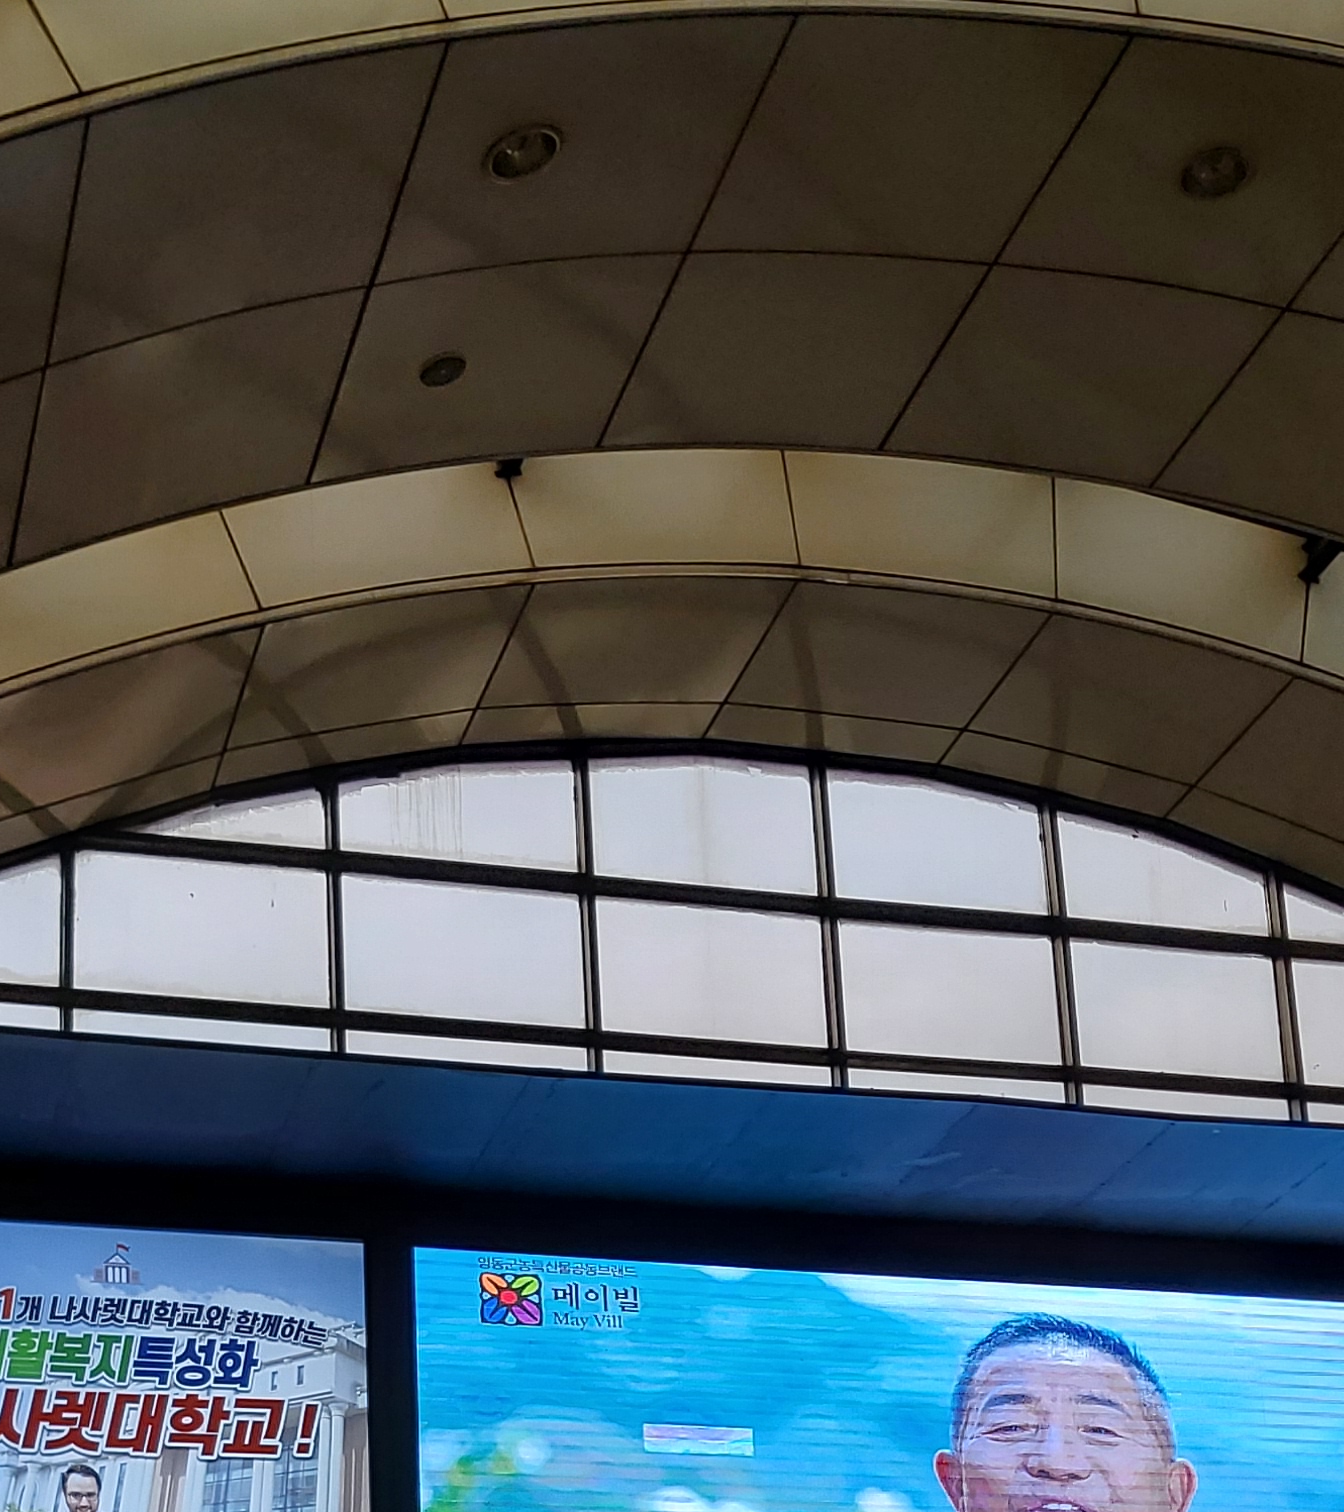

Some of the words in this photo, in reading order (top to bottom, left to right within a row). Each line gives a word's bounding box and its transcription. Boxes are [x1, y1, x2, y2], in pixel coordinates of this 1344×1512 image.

[552, 1282, 640, 1313] 메이빌
[49, 1297, 233, 1333] 나사렛대학교와
[233, 1309, 328, 1348] 함께하는
[553, 1312, 589, 1331] May
[592, 1315, 623, 1329] Vill
